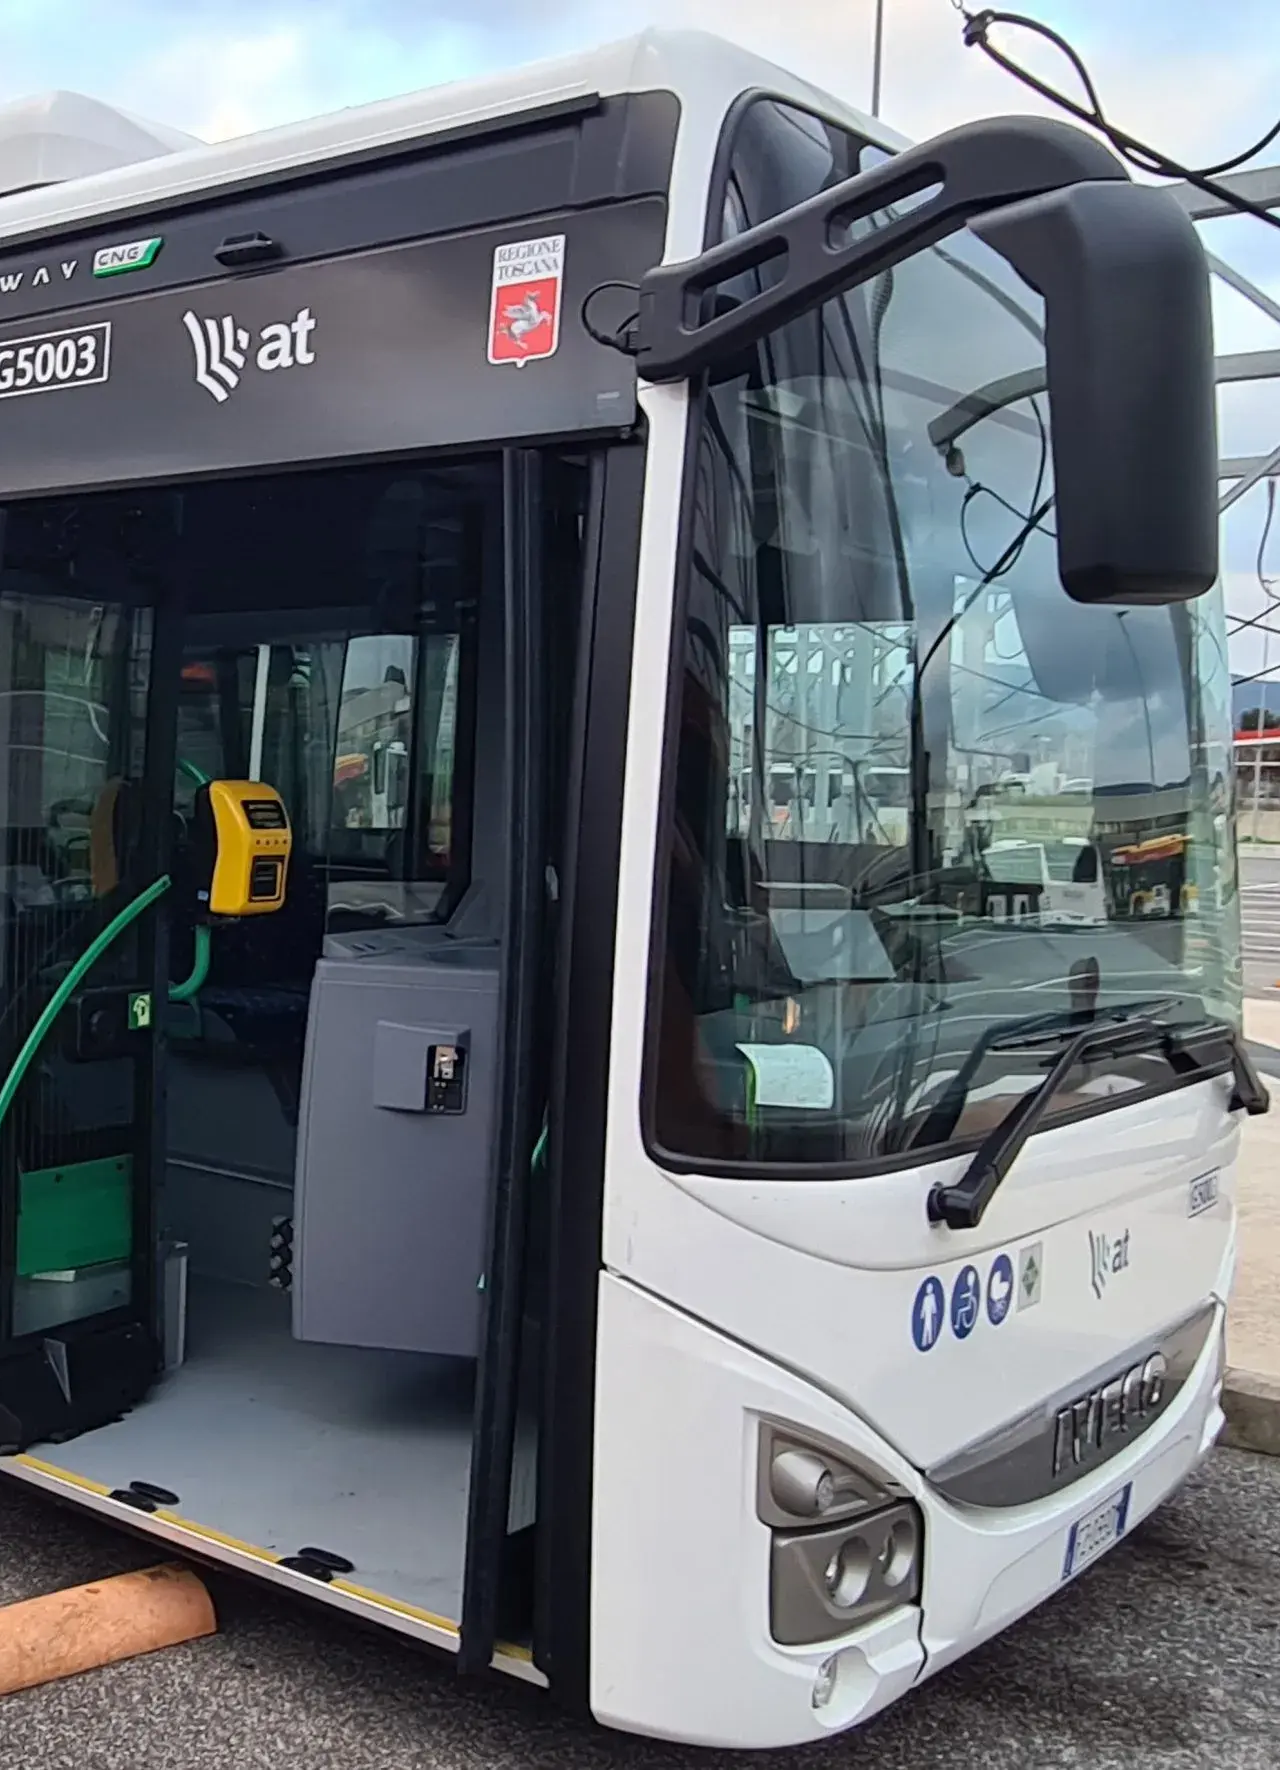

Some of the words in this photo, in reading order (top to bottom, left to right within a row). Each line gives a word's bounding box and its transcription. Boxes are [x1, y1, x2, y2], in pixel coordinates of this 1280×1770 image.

[98, 246, 141, 265] CNG
[498, 238, 561, 262] REGIONE
[498, 258, 559, 280] TOSCANA
[257, 307, 316, 371] at
